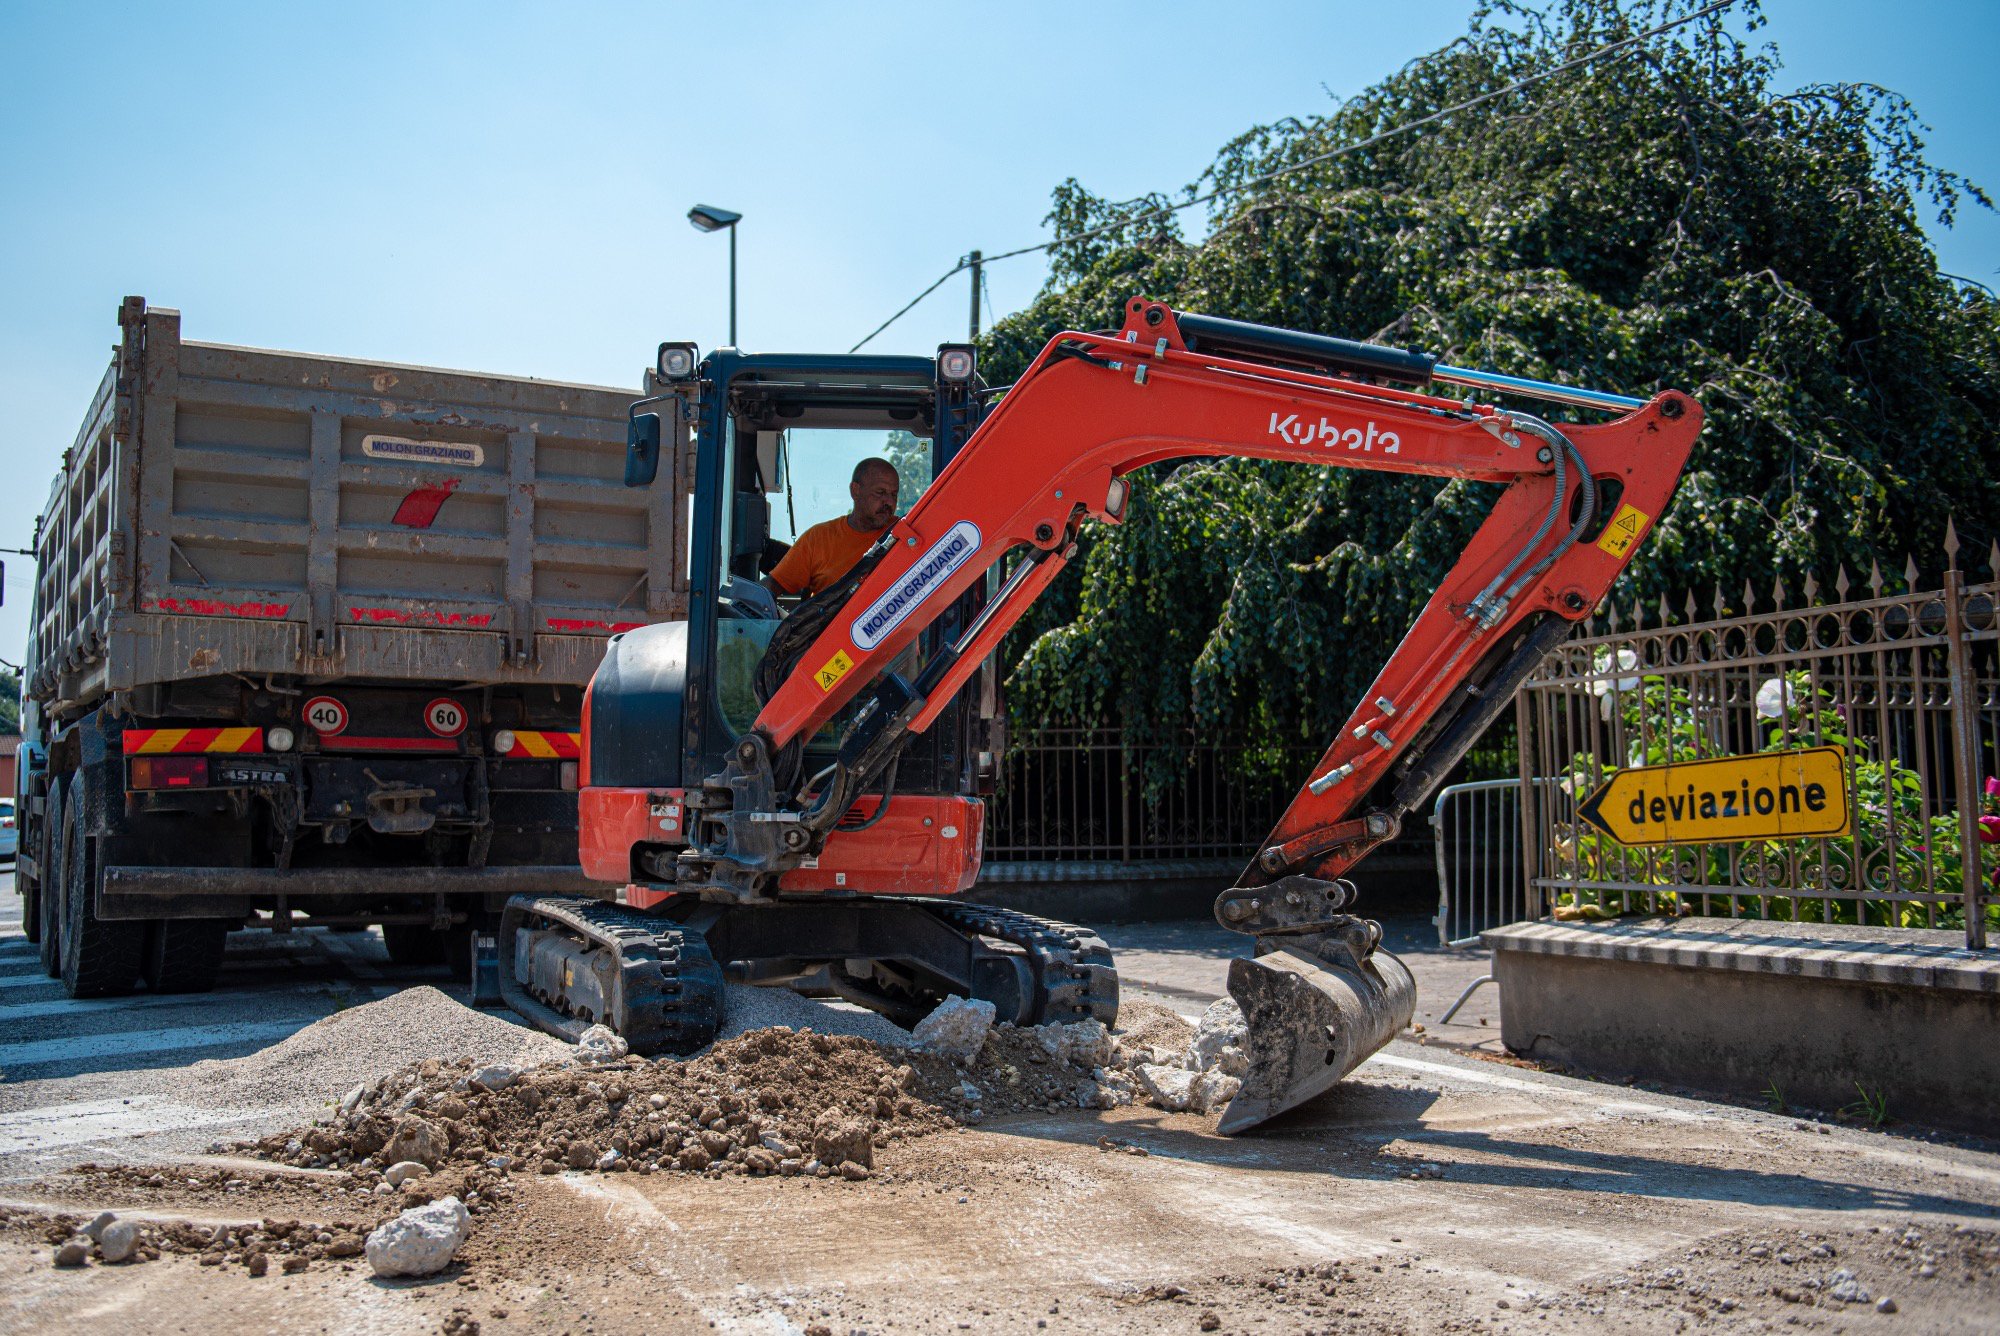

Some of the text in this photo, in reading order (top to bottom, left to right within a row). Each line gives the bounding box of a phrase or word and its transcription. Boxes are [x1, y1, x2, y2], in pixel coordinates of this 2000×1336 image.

[372, 441, 412, 454] MOLON
[415, 445, 471, 460] GRAZIANO
[1268, 412, 1400, 454] Kubota
[858, 584, 903, 627] COSTRUZIONI
[902, 565, 921, 584] EDILI
[926, 528, 960, 561] STRADALI
[862, 594, 906, 637] MOLON
[904, 539, 963, 597] GRAZIANO
[871, 590, 926, 642] ARZIGNANO (VI)
[312, 708, 338, 724] 40
[436, 709, 457, 726] 60
[1628, 778, 1826, 825] deviazione
